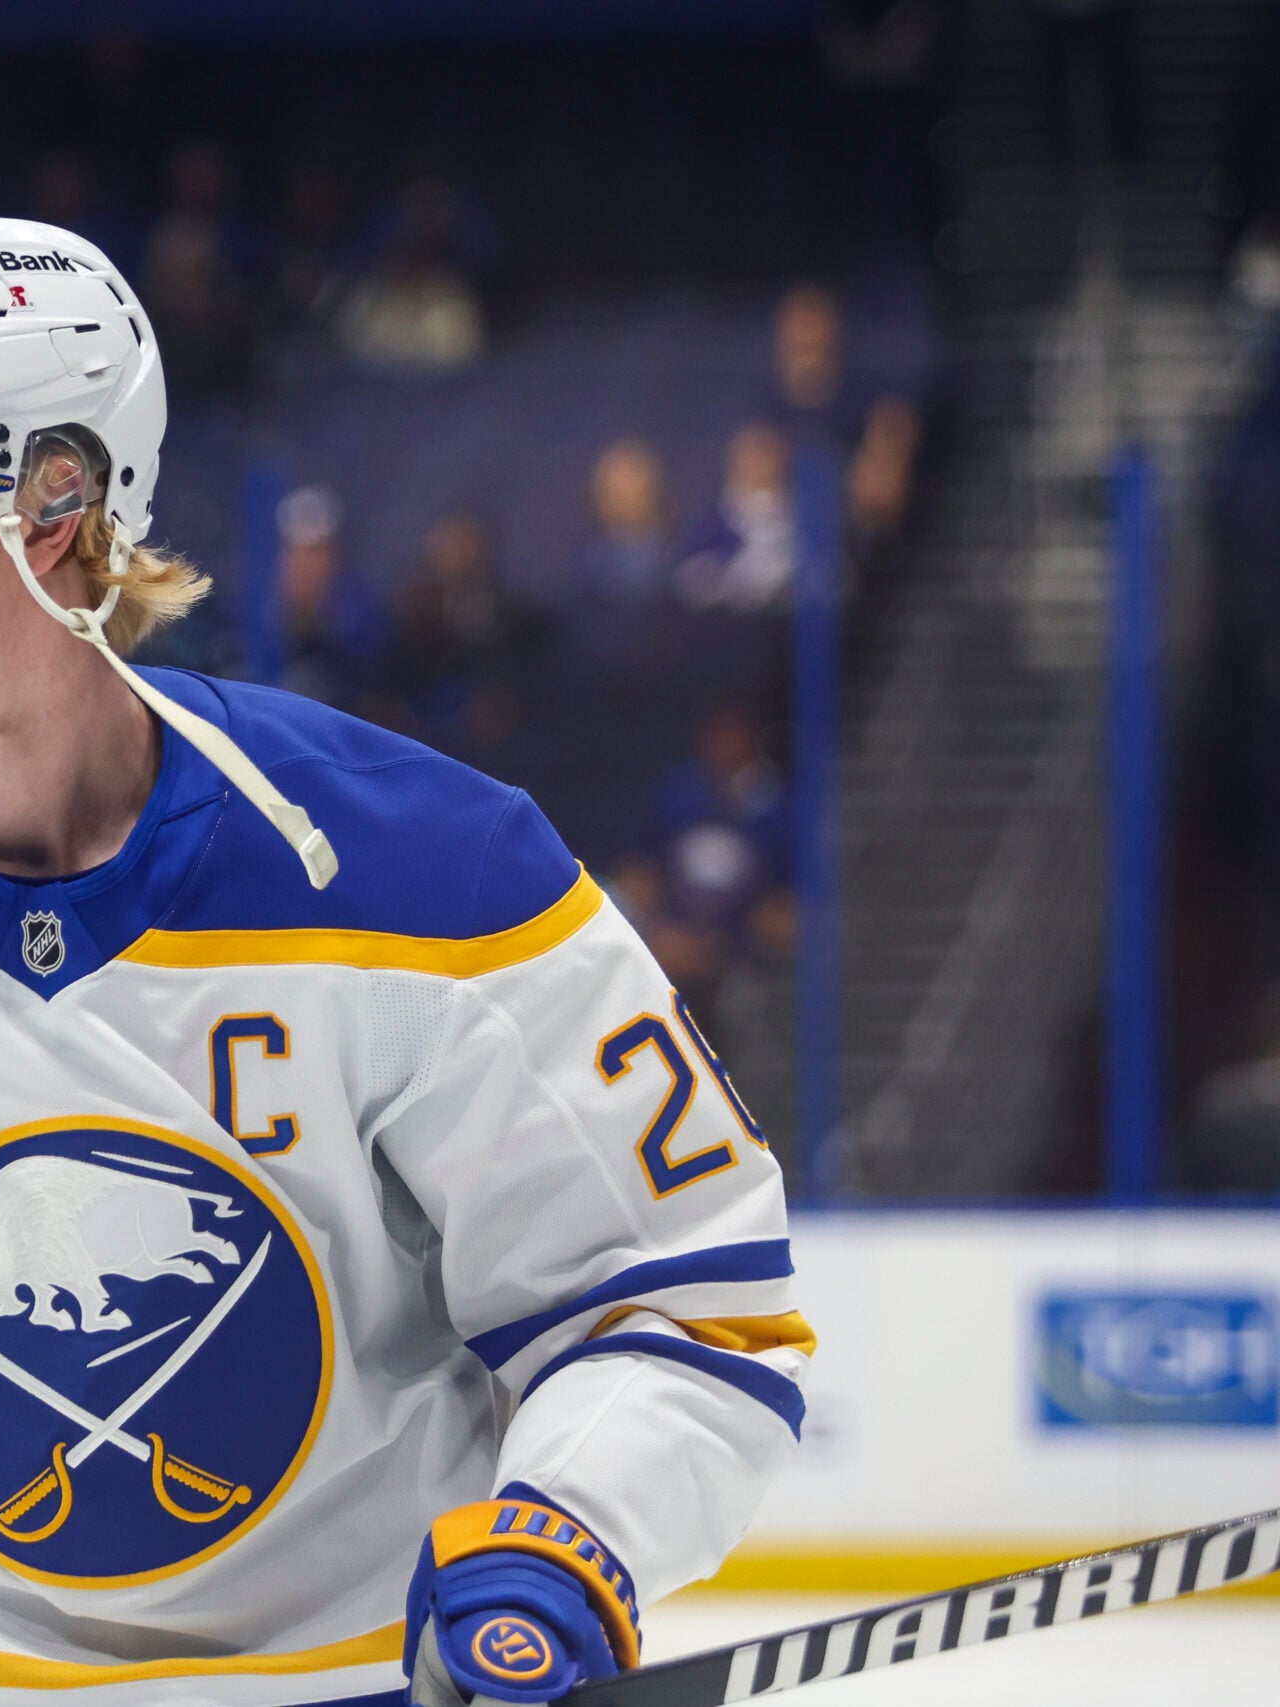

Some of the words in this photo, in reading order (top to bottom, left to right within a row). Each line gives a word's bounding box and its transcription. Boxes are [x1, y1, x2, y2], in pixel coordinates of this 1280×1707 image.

[32, 927, 56, 962] NHL
[208, 1012, 301, 1159] C
[723, 1519, 1280, 1706] WARRIO
